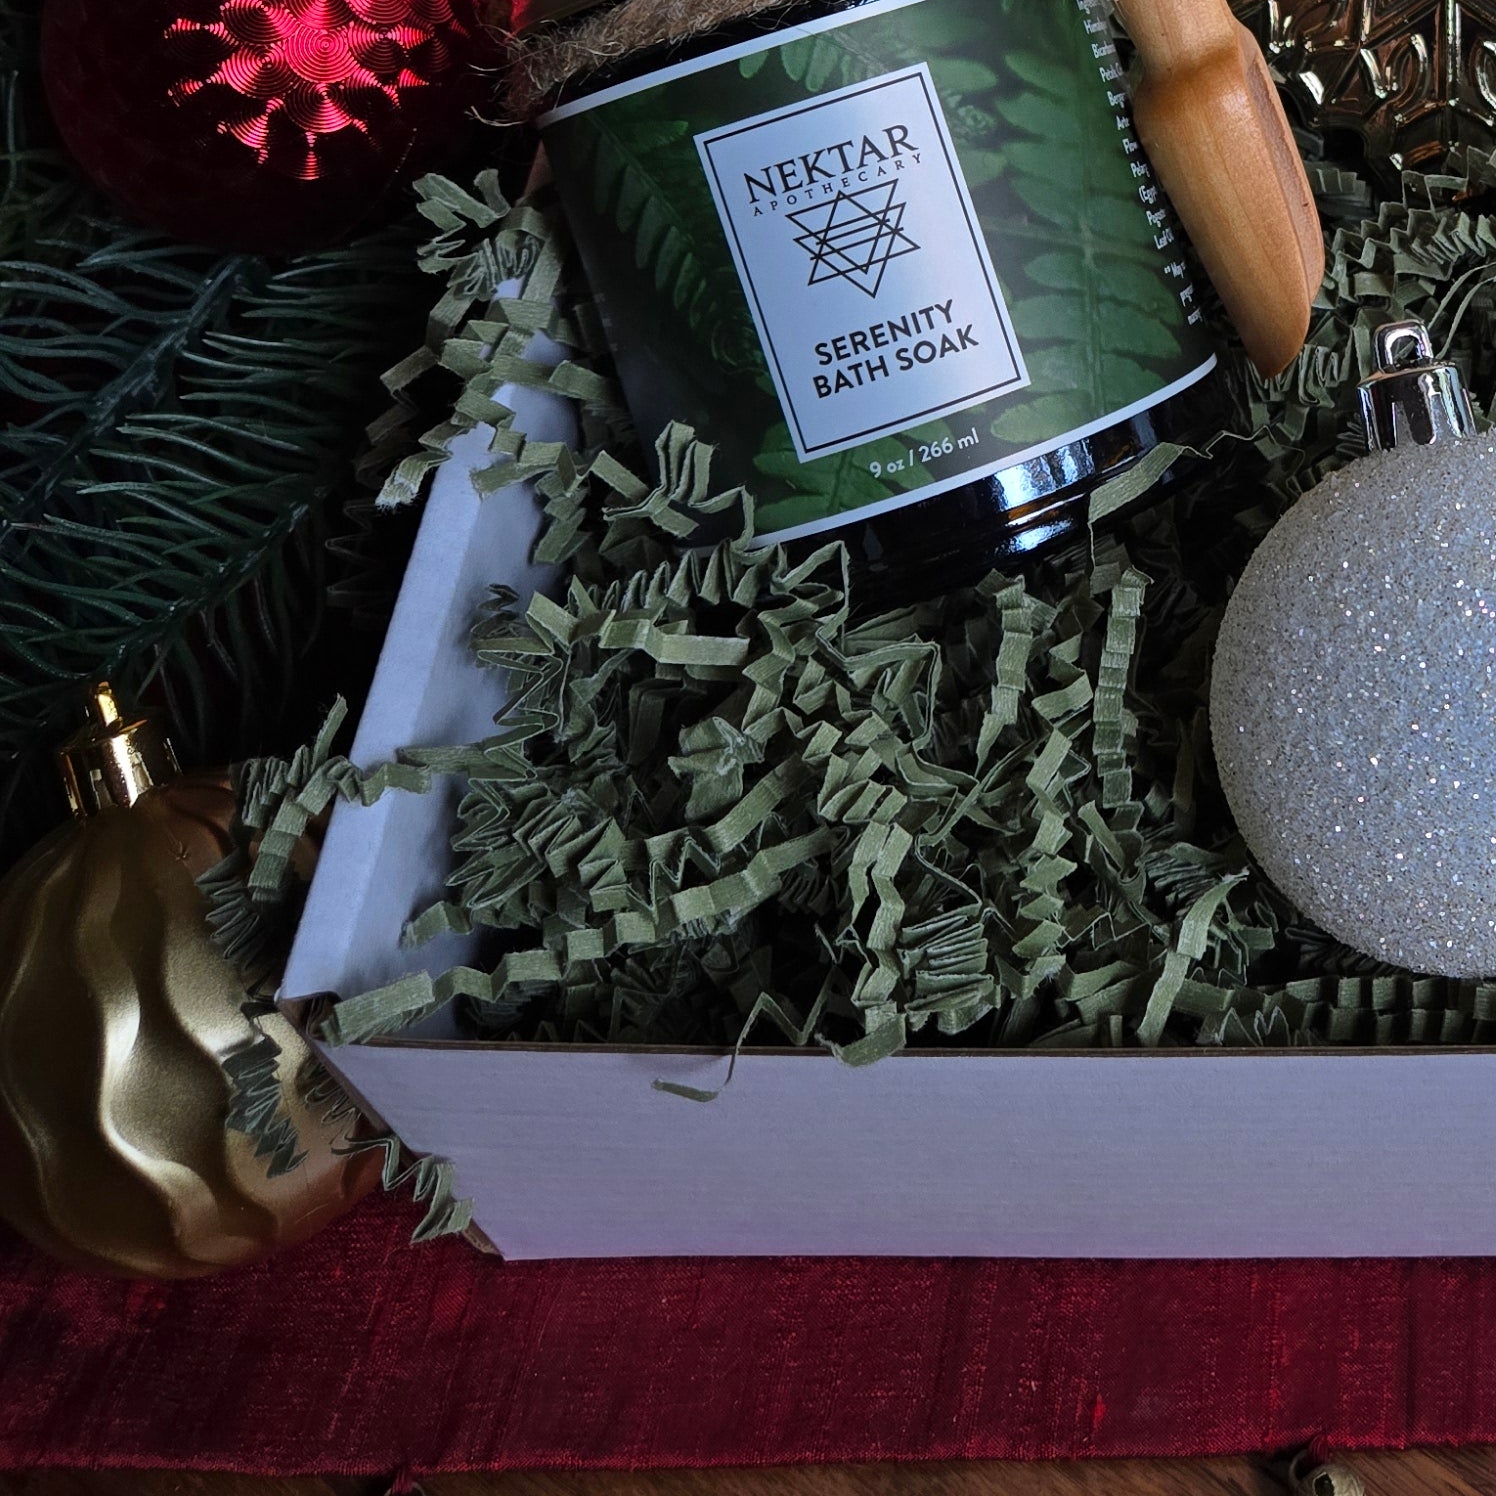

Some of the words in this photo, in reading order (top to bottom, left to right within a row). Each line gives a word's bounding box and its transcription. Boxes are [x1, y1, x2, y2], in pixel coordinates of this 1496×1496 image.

[743, 124, 919, 204] NEKTAR
[753, 153, 922, 217] APOTHECARY
[812, 355, 890, 399] BATH
[895, 324, 979, 371] SOAK
[814, 299, 953, 366] SERENITY
[869, 461, 882, 479] 9
[886, 461, 905, 474] oz
[918, 436, 954, 463] 266
[957, 427, 980, 450] ml
